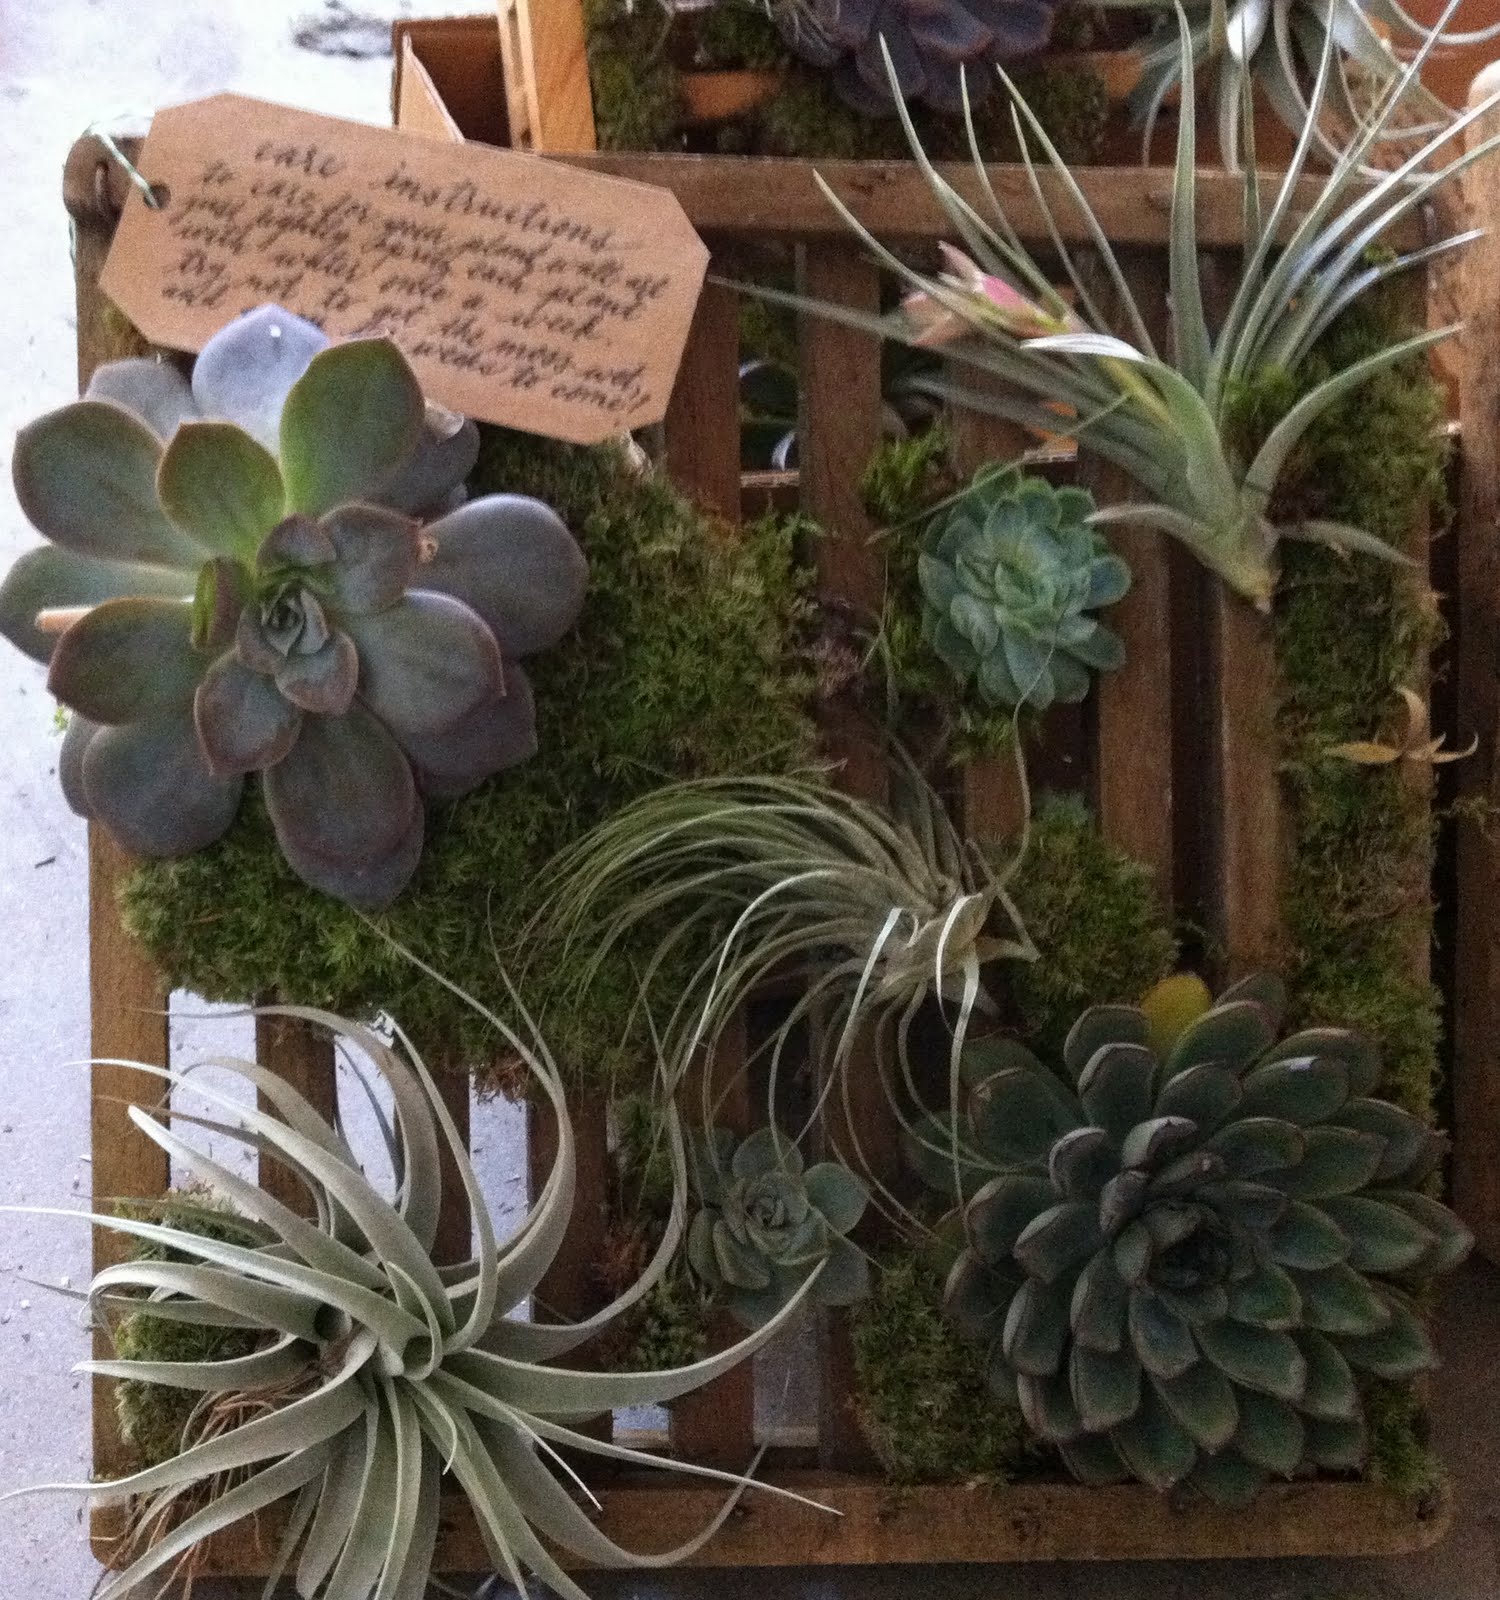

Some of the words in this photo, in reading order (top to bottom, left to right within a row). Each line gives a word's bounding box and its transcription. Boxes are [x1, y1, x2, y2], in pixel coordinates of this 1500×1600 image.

[255, 140, 346, 179] care
[369, 161, 613, 251] instructions
[202, 160, 234, 184] to
[250, 179, 317, 204] care
[312, 194, 371, 230] for
[441, 236, 551, 272] plant
[243, 274, 303, 298] not
[323, 287, 367, 312] to
[462, 294, 485, 309] a
[531, 287, 642, 320] plant
[513, 366, 539, 388] to
